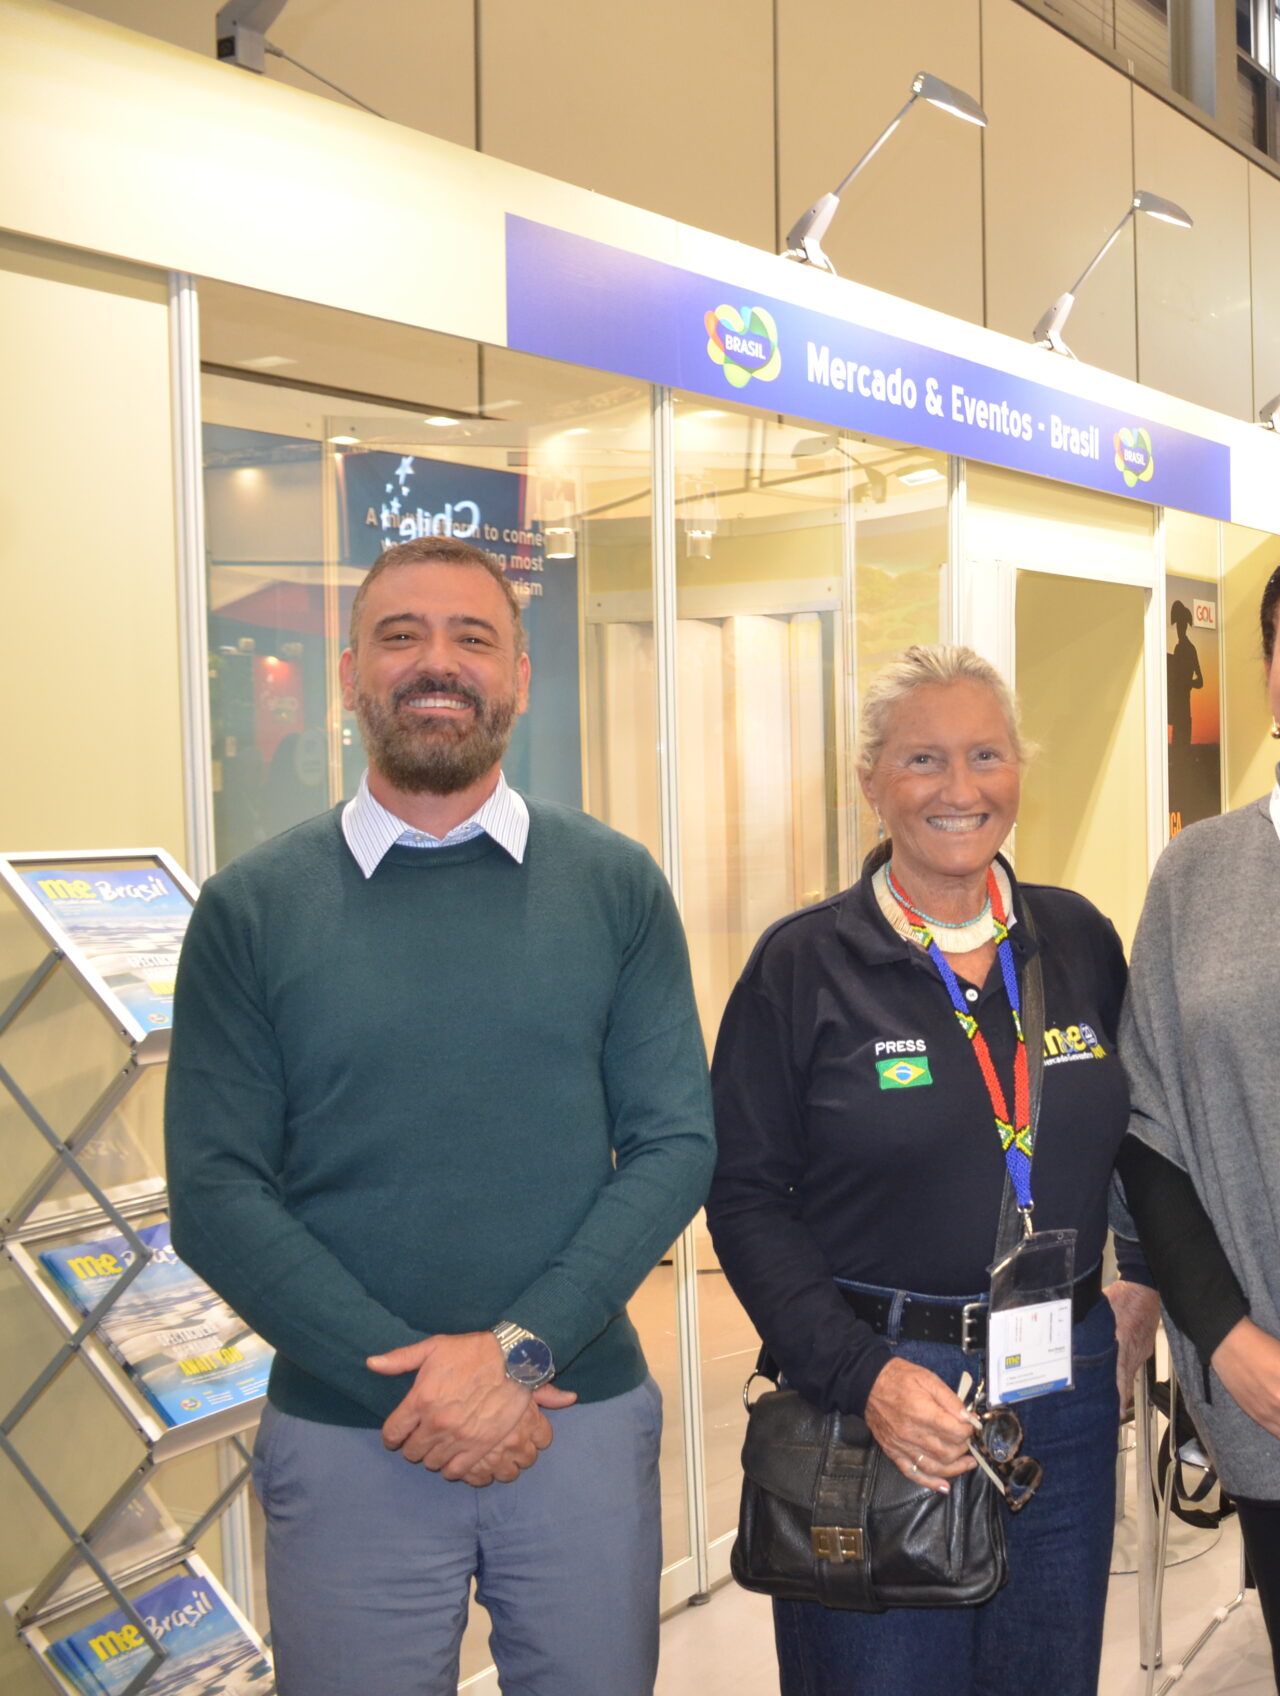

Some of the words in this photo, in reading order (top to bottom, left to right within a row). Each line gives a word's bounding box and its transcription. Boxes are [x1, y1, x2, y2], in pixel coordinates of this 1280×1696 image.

[725, 333, 766, 361] BRASIL
[806, 341, 918, 408] Mercado
[925, 377, 944, 417] &
[951, 384, 1033, 441] Eventos
[1050, 414, 1100, 461] Brasil
[1123, 448, 1146, 466] BRASIL
[365, 507, 378, 526] A
[484, 524, 499, 541] to
[502, 529, 545, 547] conne
[510, 553, 544, 572] most
[1195, 604, 1214, 624] GOL
[95, 875, 169, 902] Brasil
[875, 1039, 927, 1056] PRESS
[142, 1590, 215, 1642] Brasil
